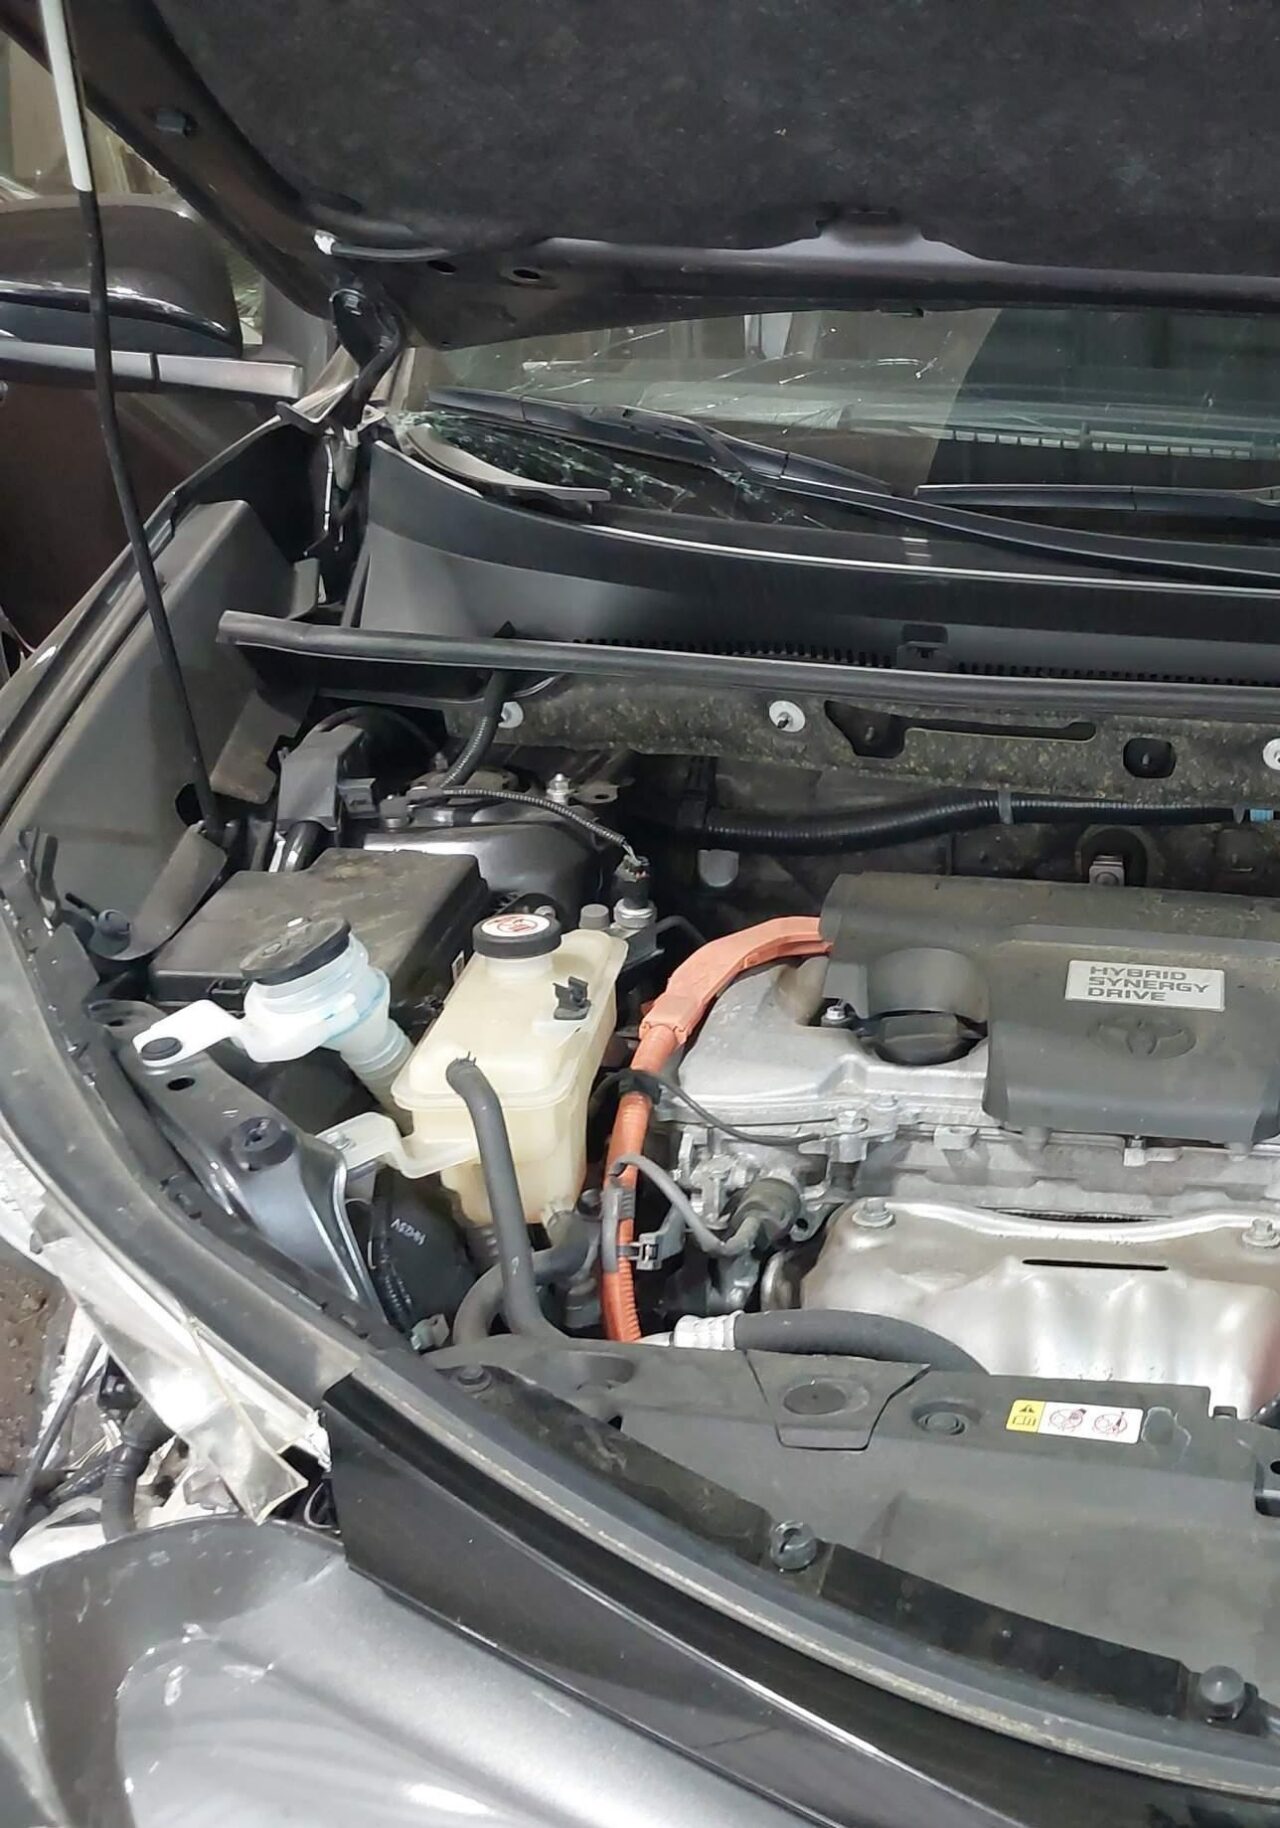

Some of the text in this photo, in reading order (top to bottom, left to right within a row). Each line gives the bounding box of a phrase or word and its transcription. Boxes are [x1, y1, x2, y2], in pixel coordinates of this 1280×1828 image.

[1089, 966, 1187, 981] HYBRID
[1088, 976, 1209, 993] SYNERGY
[1087, 987, 1167, 1002] DRIVE
